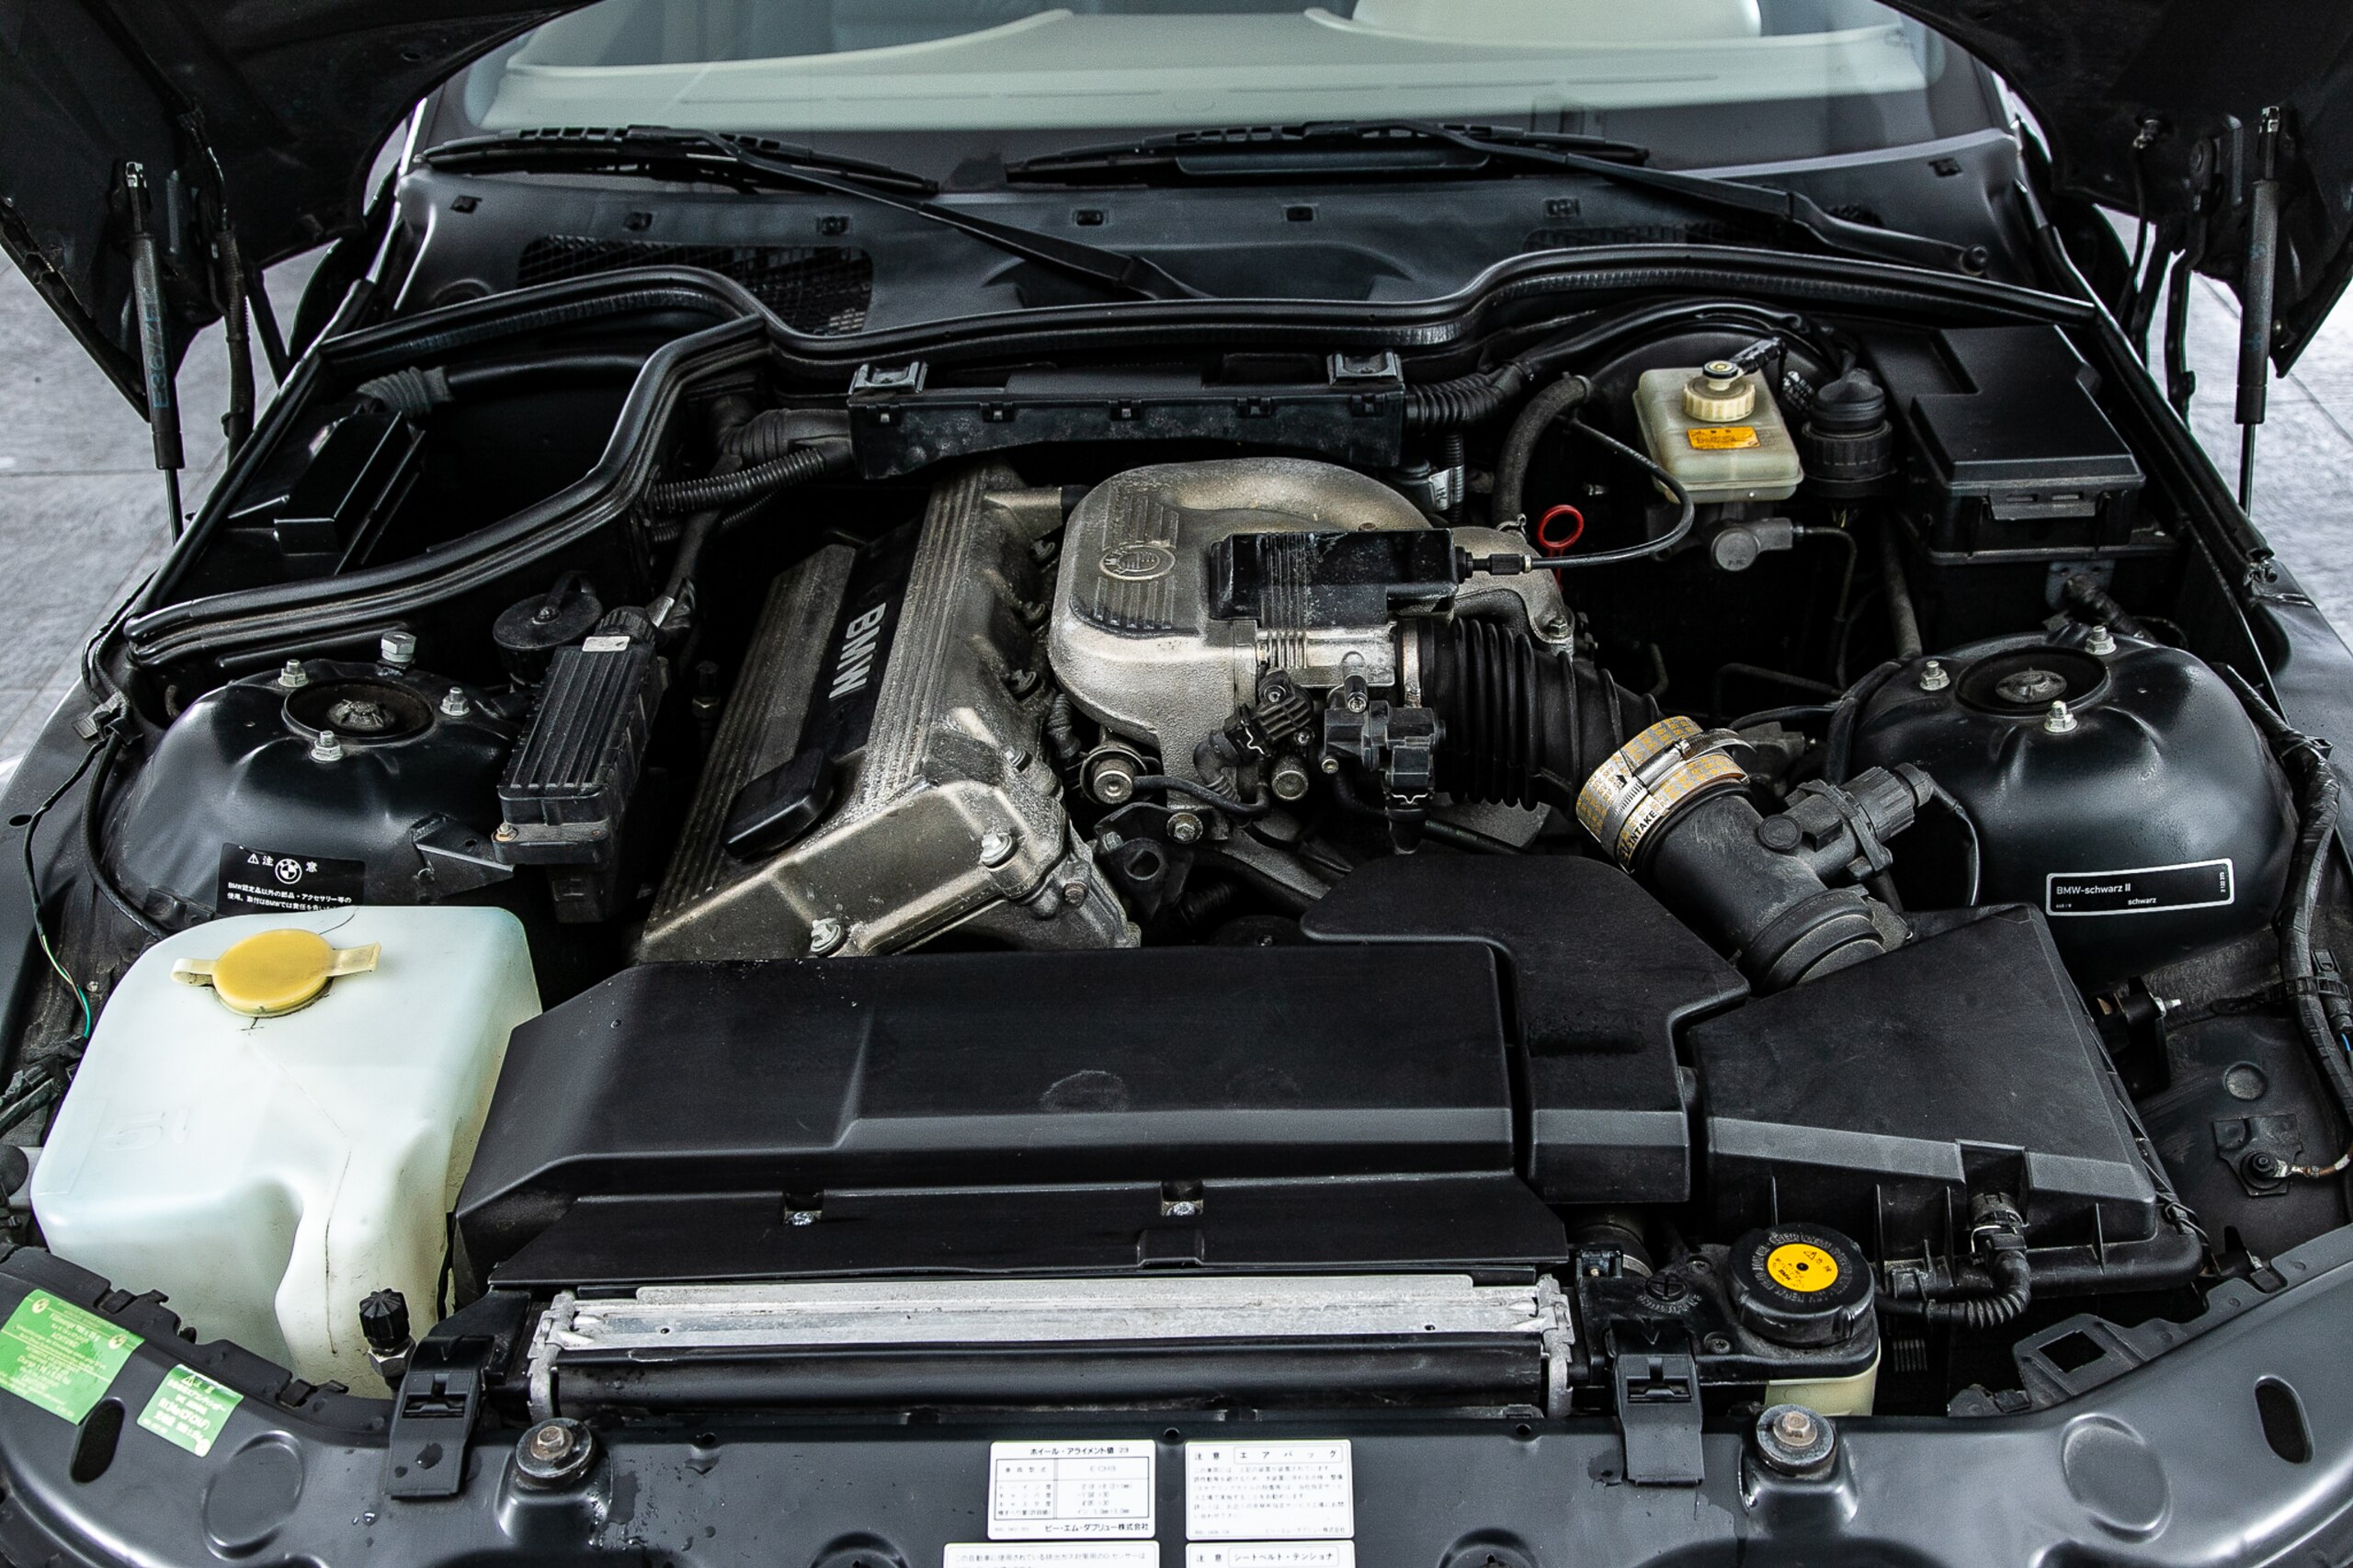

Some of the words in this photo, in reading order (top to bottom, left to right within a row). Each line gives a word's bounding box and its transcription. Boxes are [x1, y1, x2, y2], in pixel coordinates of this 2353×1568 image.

[828, 603, 886, 699] BMW
[1629, 810, 1658, 845] INTAKE
[2056, 884, 2122, 895] BMW-schwarz
[2128, 897, 2156, 905] schwarz
